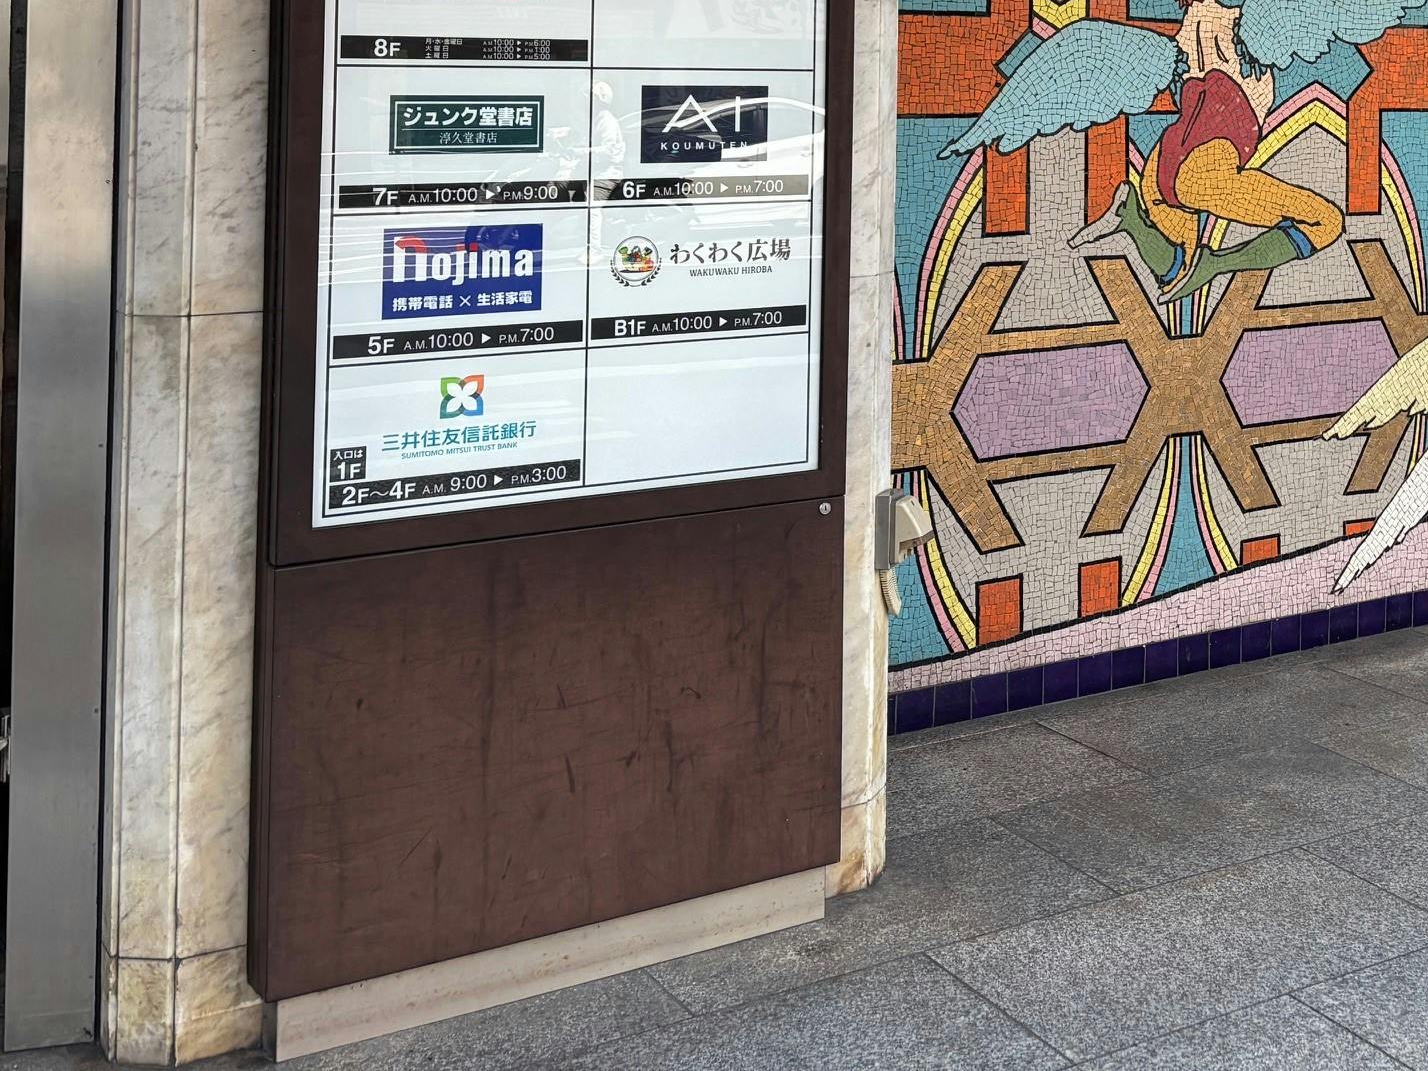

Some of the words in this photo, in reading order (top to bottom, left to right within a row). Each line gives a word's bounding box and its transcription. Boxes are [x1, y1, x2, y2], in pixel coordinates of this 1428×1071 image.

[374, 38, 401, 58] 8F
[403, 106, 533, 127] ジュンク堂書店
[439, 131, 498, 145] 淳久堂書店
[660, 141, 748, 151] KOUMUTEN
[372, 187, 398, 206] 7F
[622, 181, 646, 198] 6F
[392, 235, 534, 286] nojima
[670, 238, 791, 264] わくわく広場
[689, 268, 739, 277] WAKUWAKU
[741, 265, 773, 276] HIROBA
[392, 294, 453, 312] 携帯電話
[477, 290, 533, 306] 生活家電
[614, 319, 646, 336] B1F
[367, 335, 395, 355] 5F
[381, 420, 537, 452] 三井住友信託銀行
[333, 449, 364, 461] 入口は
[401, 449, 444, 460] SUMITOMO
[446, 446, 472, 455] MITSUI
[473, 444, 495, 453] TRUST
[497, 442, 518, 450] BANK
[337, 461, 362, 480] 1F
